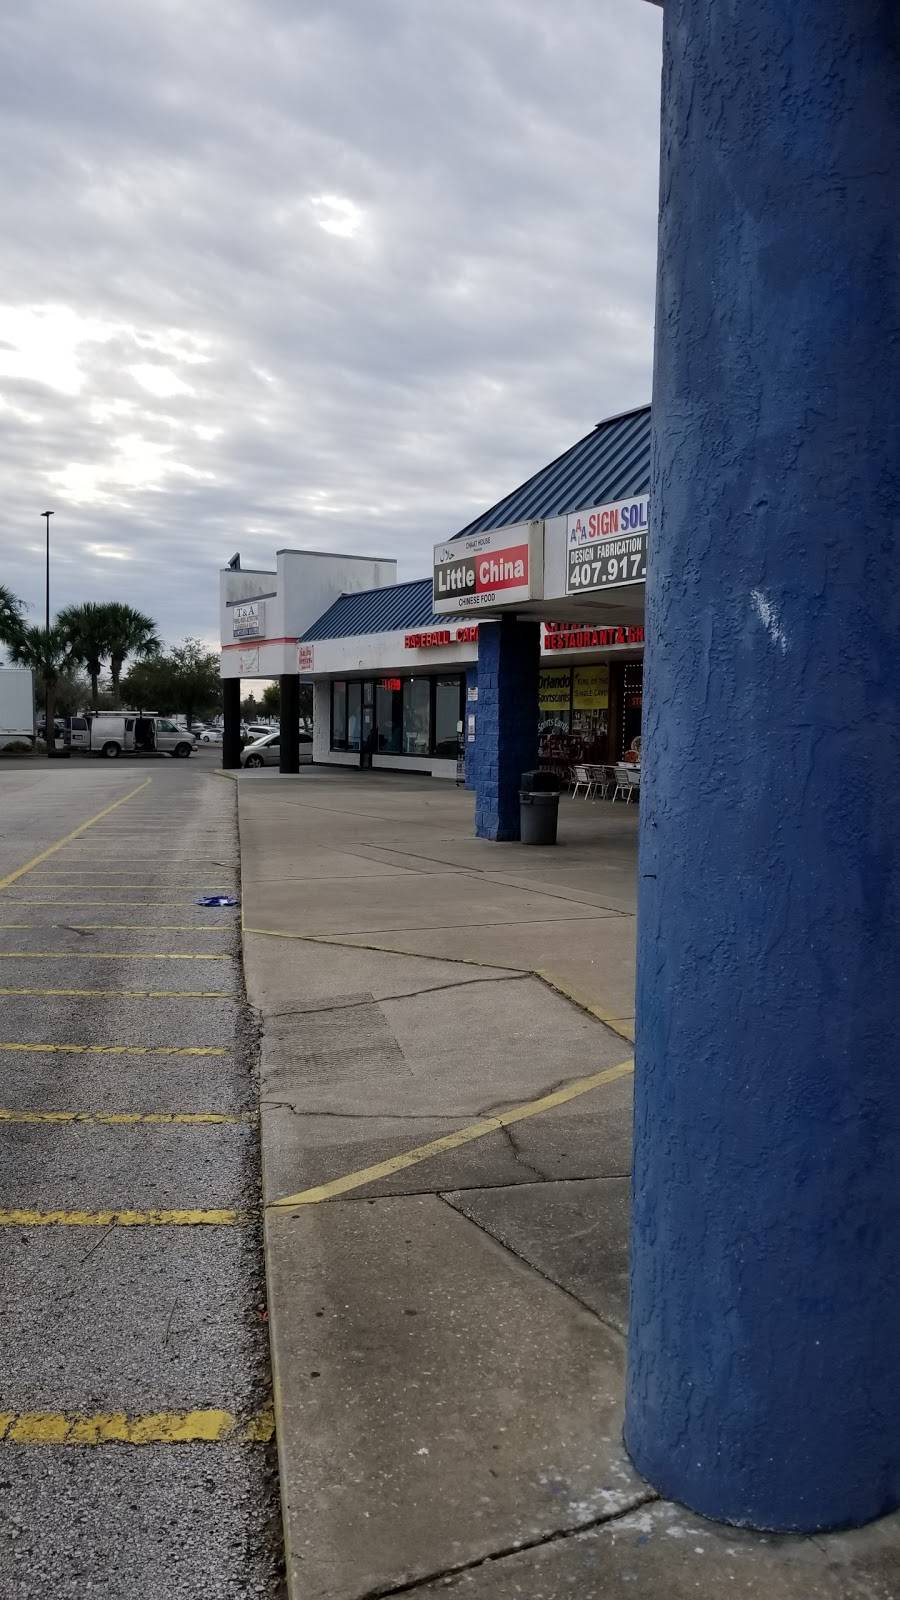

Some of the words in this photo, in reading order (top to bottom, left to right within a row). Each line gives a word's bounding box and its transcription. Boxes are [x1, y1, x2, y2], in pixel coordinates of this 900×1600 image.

[588, 508, 619, 538] SIGN
[570, 546, 594, 565] DESIGN
[597, 537, 642, 560] FABRICATION
[438, 565, 475, 593] Little
[479, 558, 525, 585] China
[458, 595, 480, 607] CHINESE
[480, 592, 496, 604] FOOD
[404, 630, 450, 649] BASEBALL
[455, 626, 479, 642] CAR
[544, 628, 615, 650] RESTAURANT
[615, 626, 625, 644] &
[538, 674, 570, 689] Orlando
